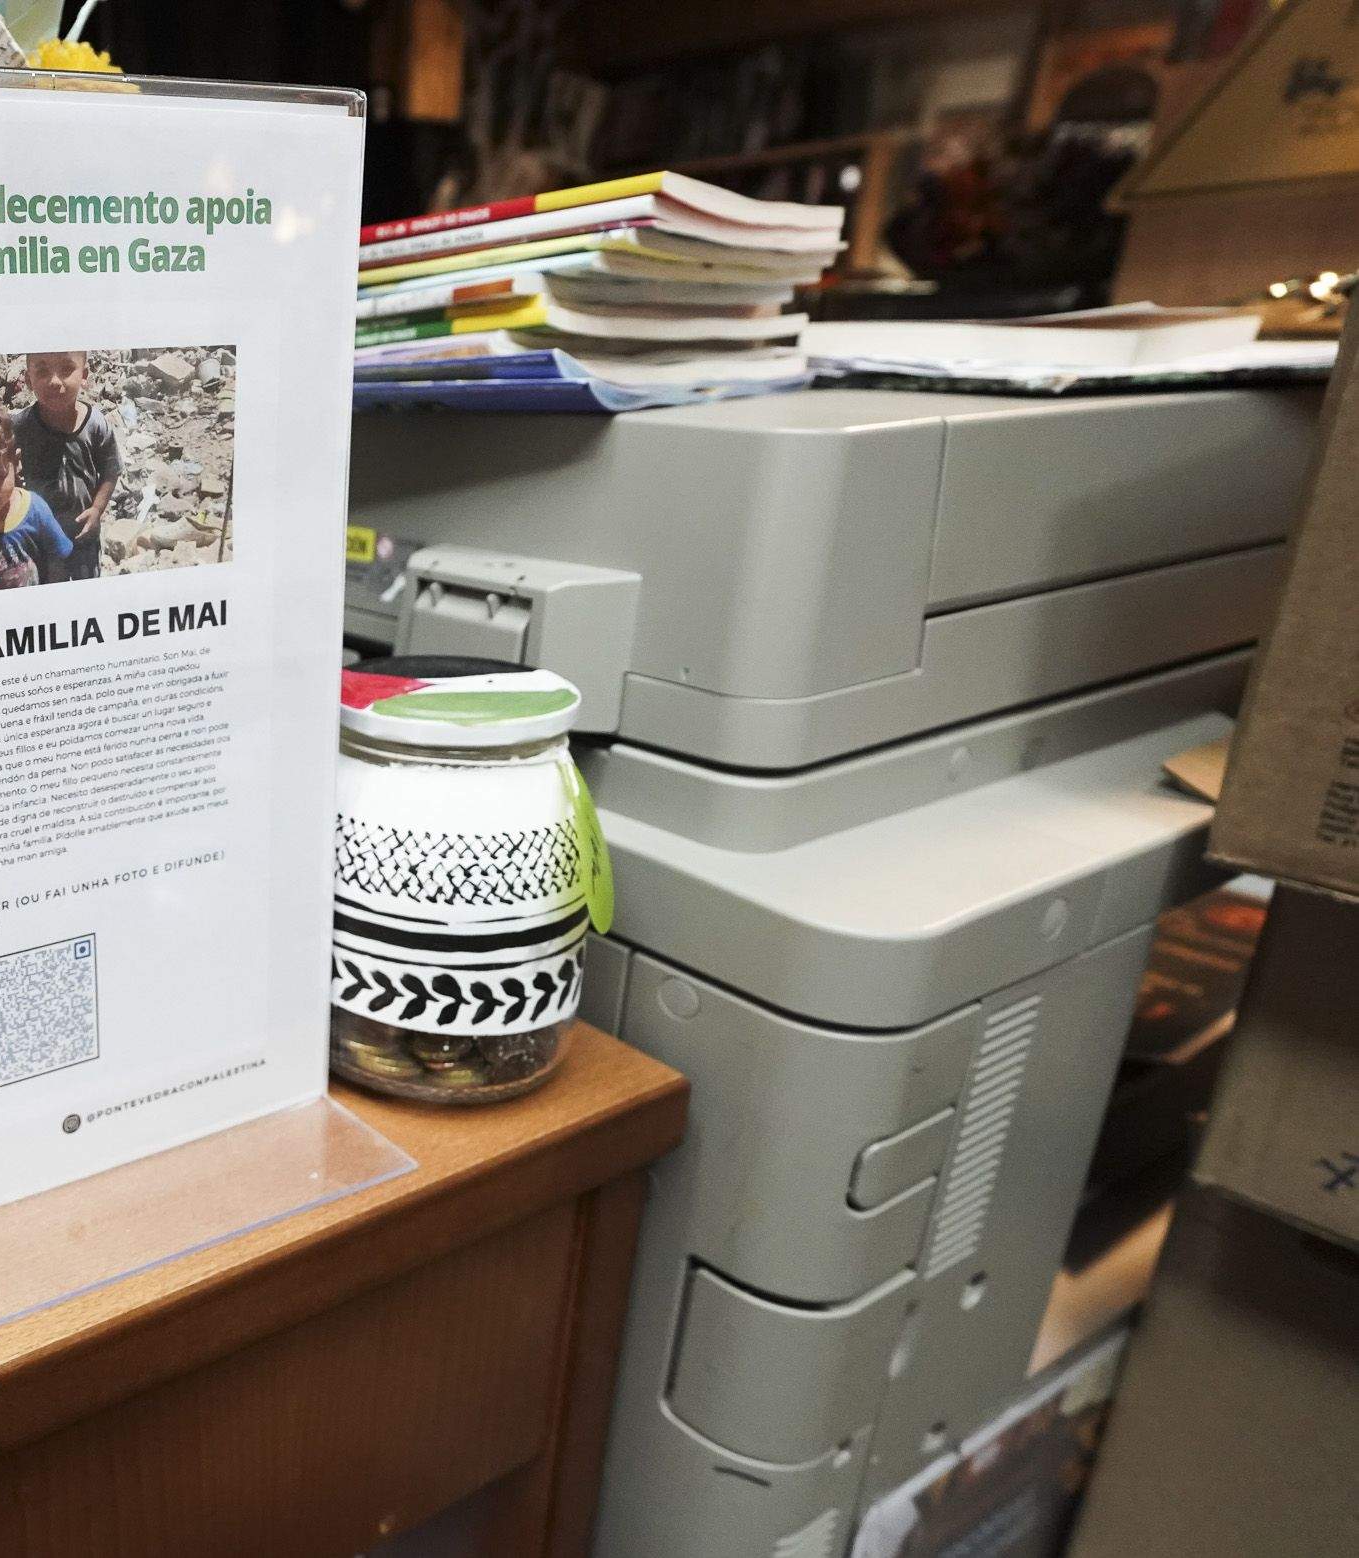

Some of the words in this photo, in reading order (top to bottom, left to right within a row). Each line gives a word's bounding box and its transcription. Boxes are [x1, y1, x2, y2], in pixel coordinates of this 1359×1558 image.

[186, 189, 272, 235] apoia
[77, 244, 120, 273] en
[128, 238, 205, 272] Gaza
[117, 609, 161, 641] DE
[167, 600, 228, 631] MAI
[15, 893, 40, 909] (OU
[45, 887, 66, 900] FAI
[71, 878, 109, 894] UNHA
[114, 868, 148, 884] FOTO
[152, 864, 159, 875] E
[164, 850, 225, 872] DIFUNDE)
